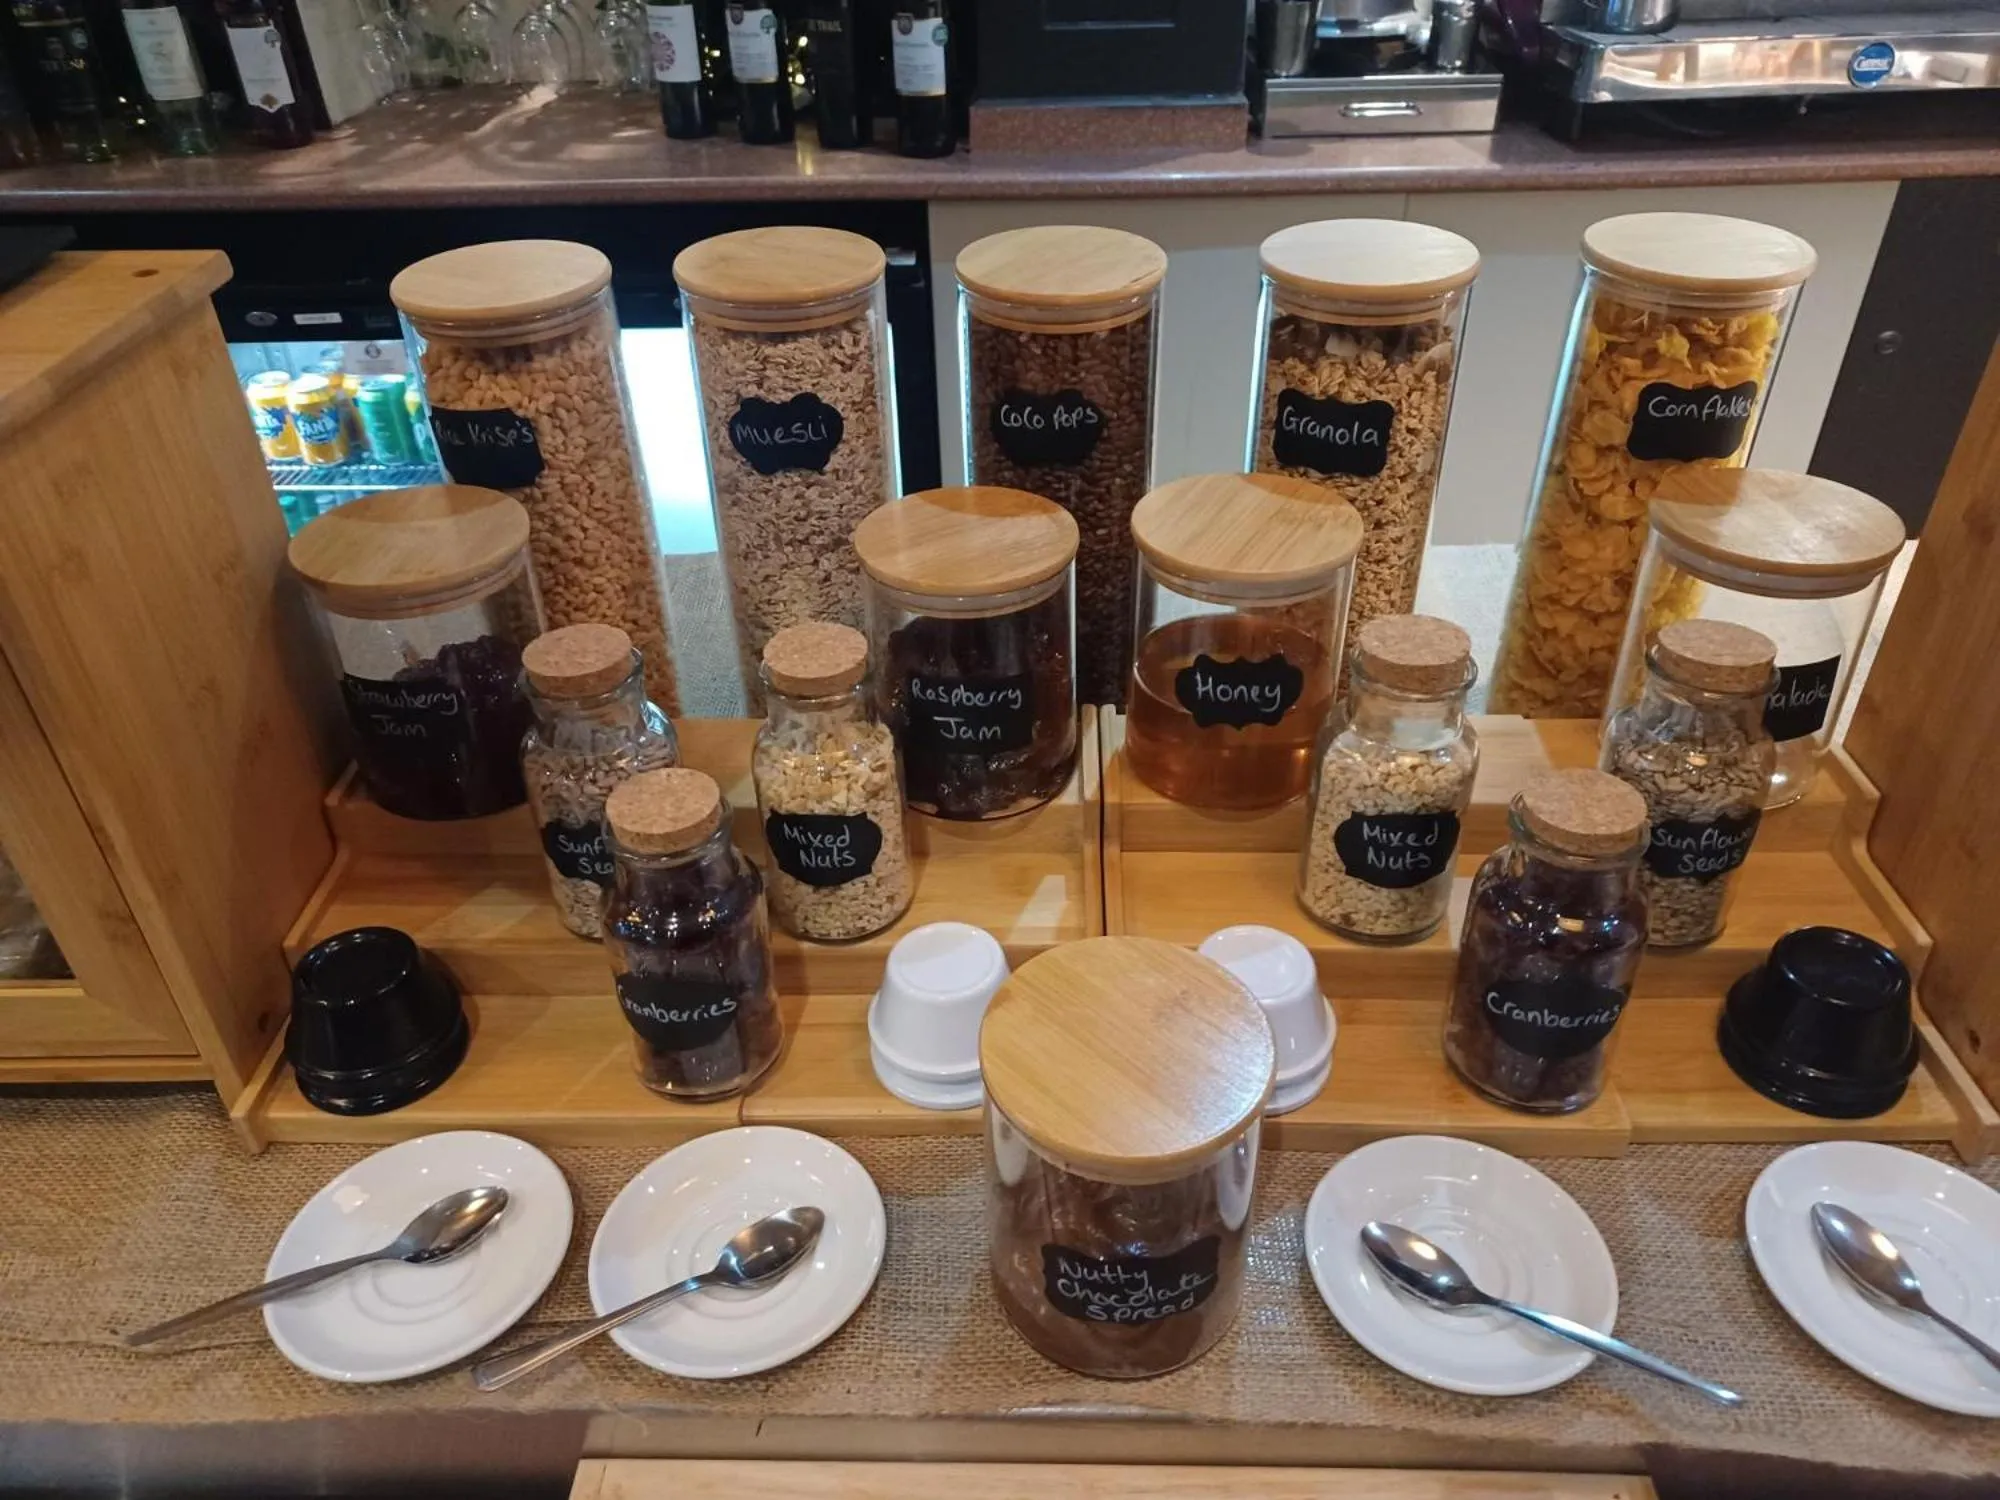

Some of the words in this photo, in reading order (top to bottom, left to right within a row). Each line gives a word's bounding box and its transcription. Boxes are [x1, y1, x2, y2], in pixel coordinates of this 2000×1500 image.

[1282, 405, 1378, 447] Granola
[911, 678, 1021, 709] Raspberry
[1195, 670, 1281, 712] Honey
[370, 714, 427, 738] Jam
[932, 716, 1001, 741] Jam
[783, 821, 851, 848] Mixed
[1363, 820, 1439, 848] Mixed
[800, 846, 857, 868] Nuts
[1367, 845, 1431, 870] Nuts
[1058, 1256, 1149, 1295] Nutty
[1085, 1291, 1196, 1322] Spread
